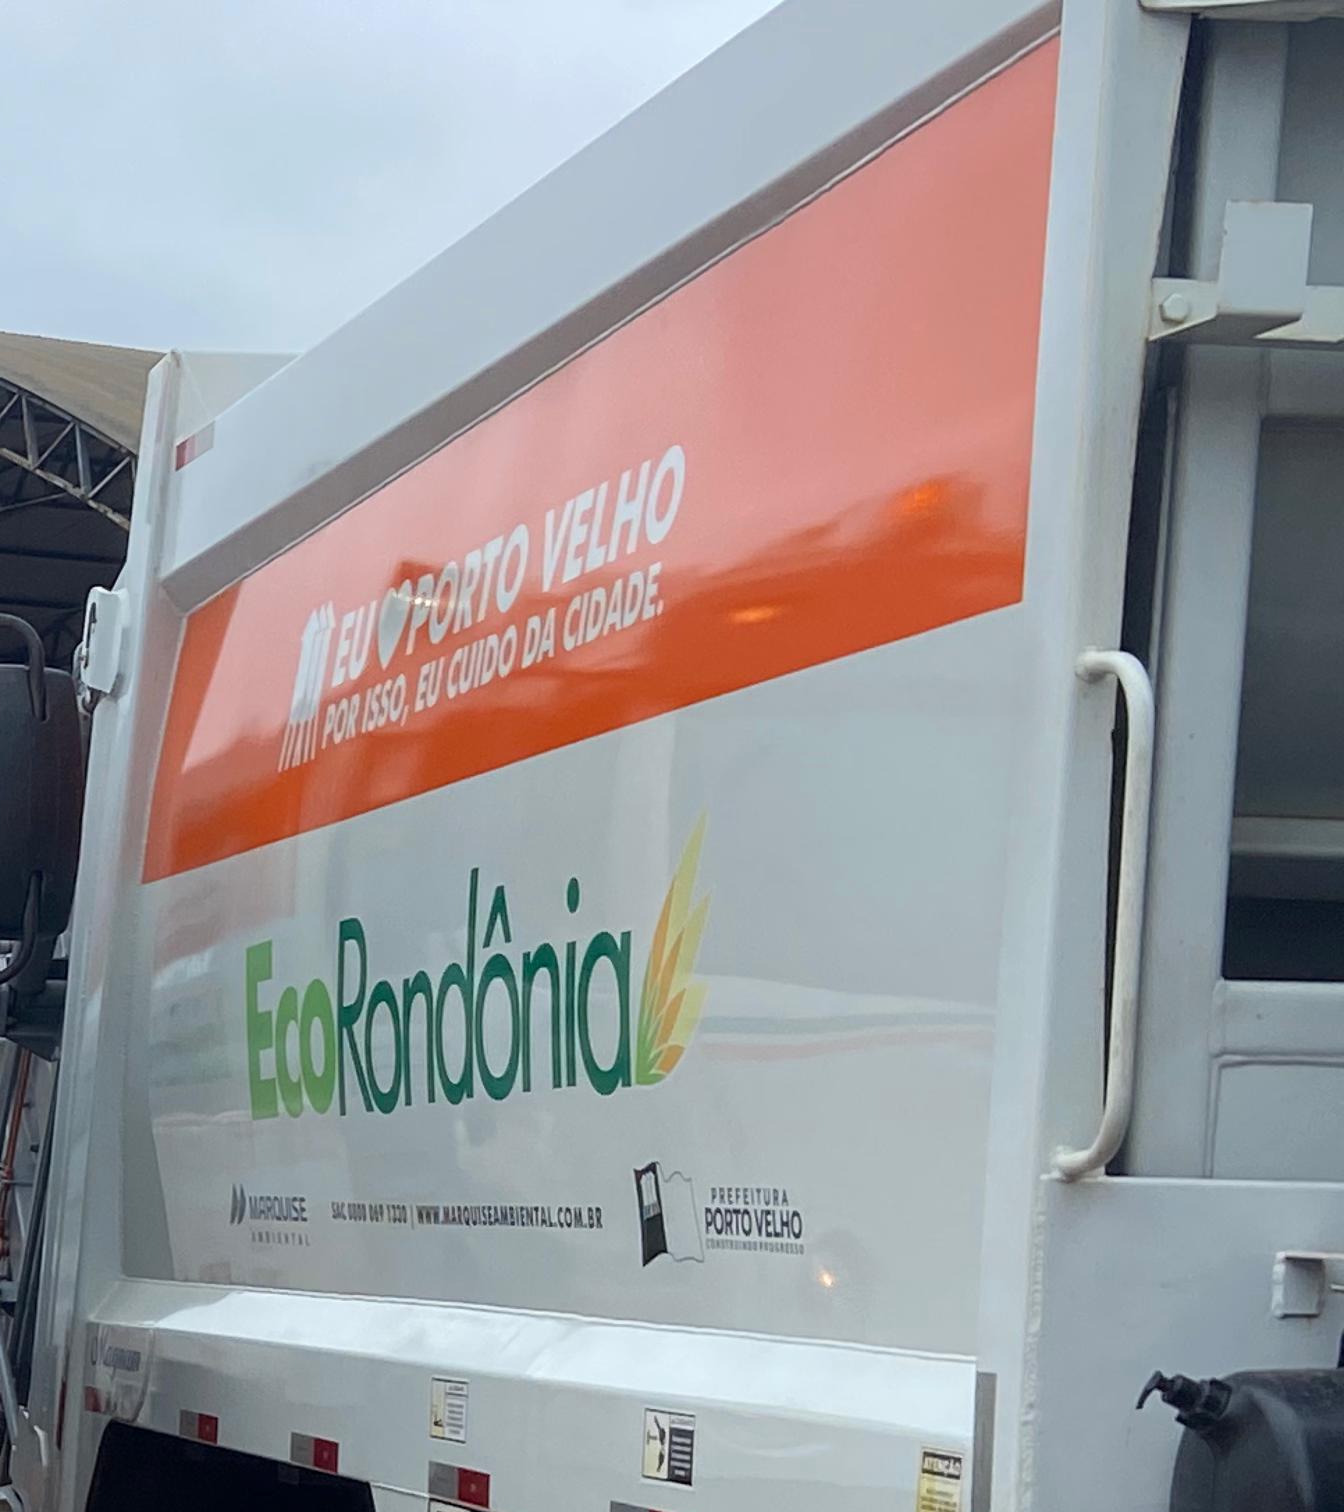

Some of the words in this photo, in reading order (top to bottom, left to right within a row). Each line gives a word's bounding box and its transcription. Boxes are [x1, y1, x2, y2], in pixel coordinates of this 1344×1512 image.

[322, 692, 360, 749] POR
[361, 673, 409, 727] ISSO,
[413, 651, 446, 713] EU
[446, 624, 518, 698] CUIDO
[521, 607, 556, 669] DA
[562, 561, 665, 652] CIDADE.
[331, 600, 377, 688] EU
[405, 523, 530, 656] PORTO
[542, 444, 685, 592] VELHO
[245, 866, 633, 1121] EcoRondônia
[704, 1207, 753, 1237] PORTO
[755, 1209, 803, 1240] VELHO
[710, 1187, 790, 1207] PREFEITURA
